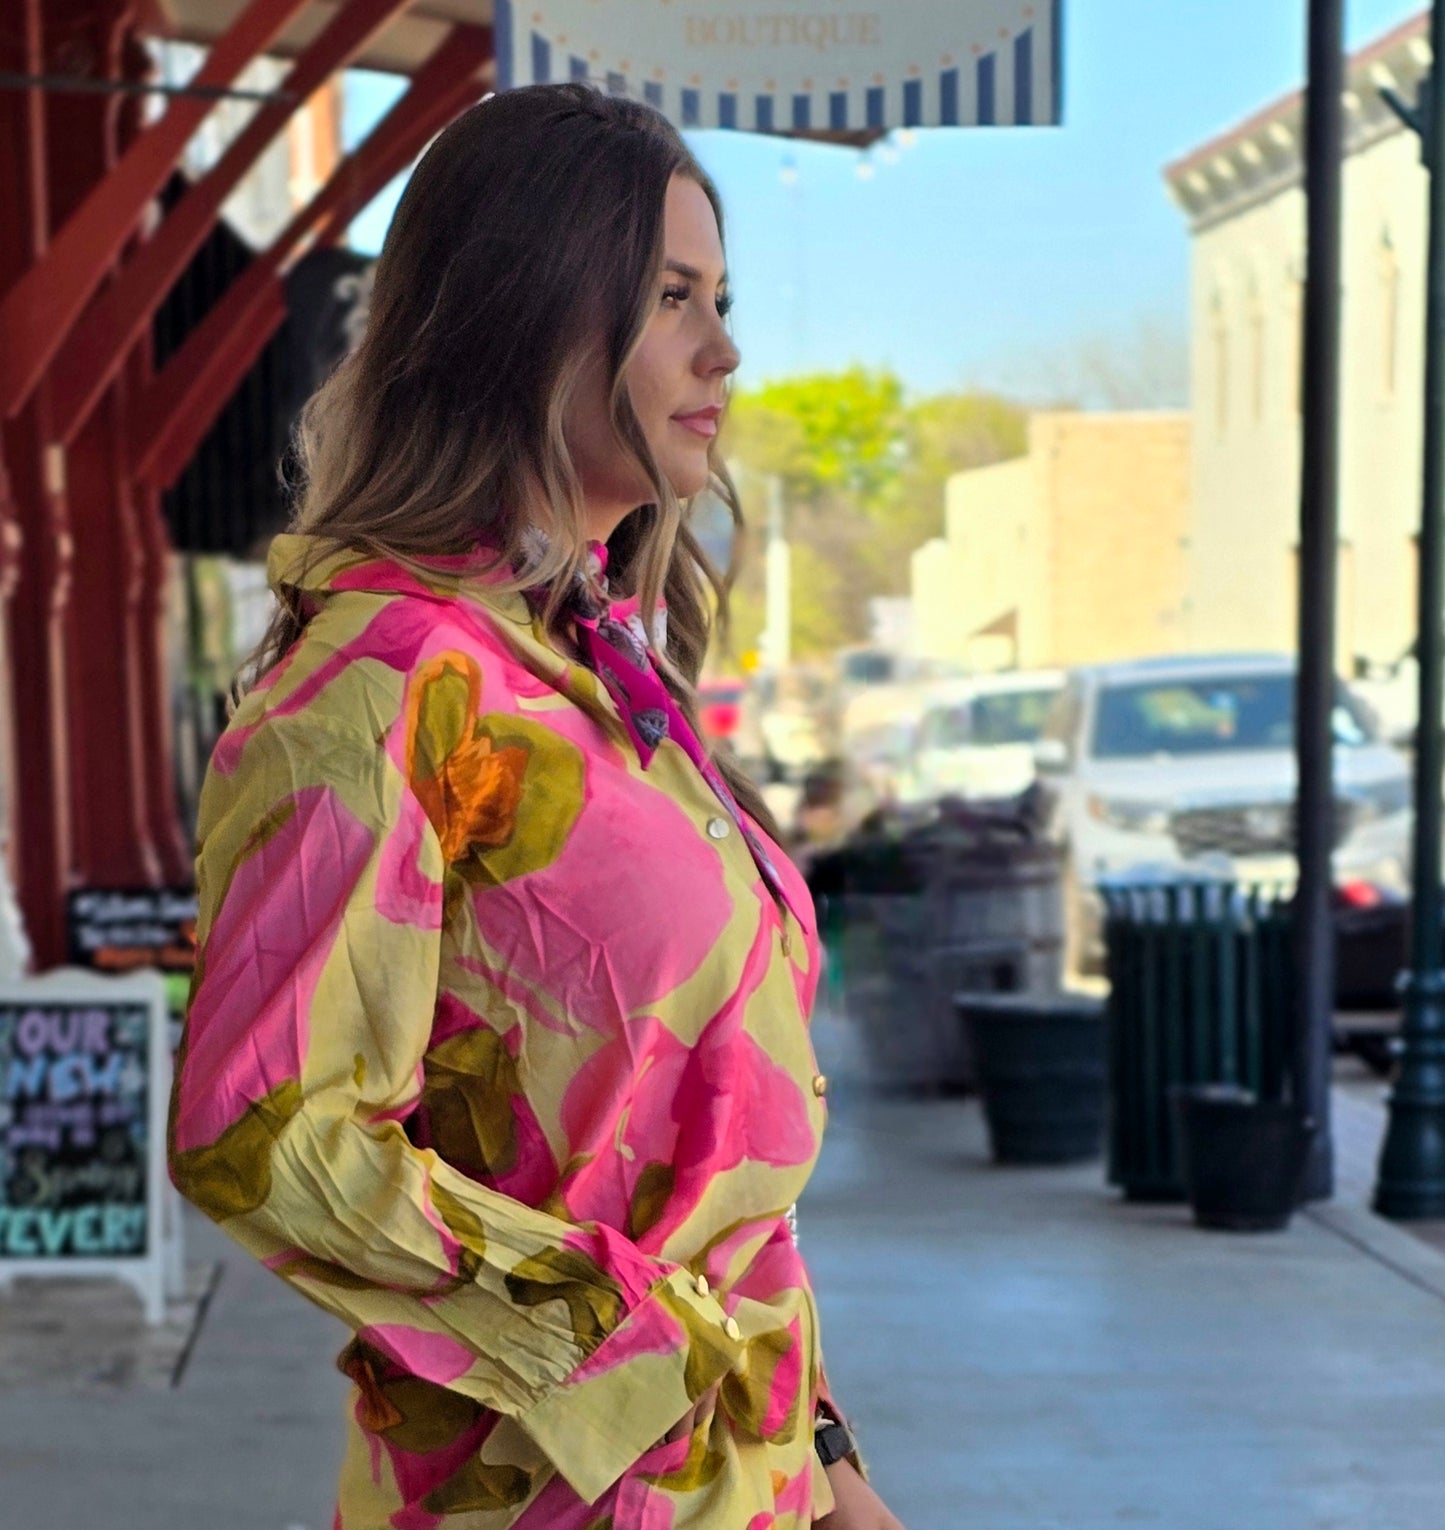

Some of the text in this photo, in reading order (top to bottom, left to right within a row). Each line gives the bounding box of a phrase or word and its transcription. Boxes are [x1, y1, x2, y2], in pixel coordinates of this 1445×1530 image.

[683, 13, 882, 50] BOUTIQUE
[17, 1010, 110, 1055] OUR
[6, 1053, 124, 1101] NEW
[0, 1203, 145, 1256] EVER!
